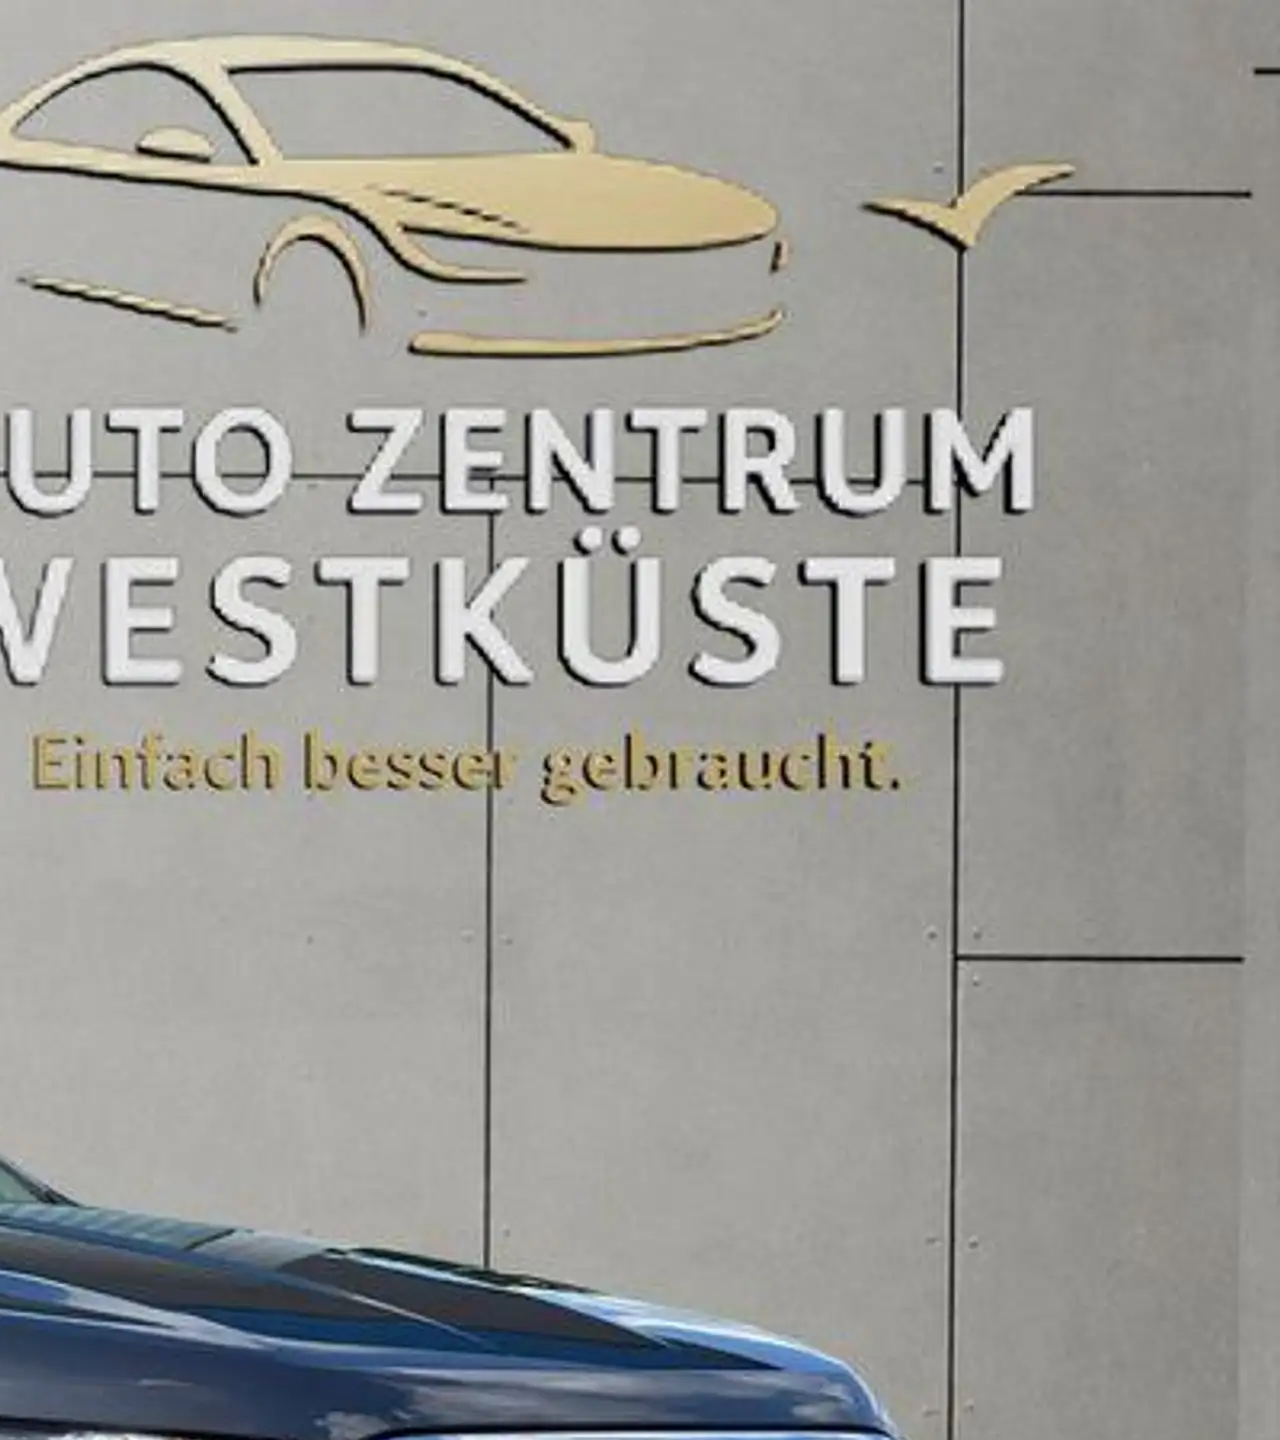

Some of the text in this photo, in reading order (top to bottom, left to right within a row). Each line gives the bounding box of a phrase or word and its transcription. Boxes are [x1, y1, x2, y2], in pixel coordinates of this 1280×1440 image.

[346, 407, 1035, 516] ZENTRUM
[30, 727, 902, 807] Einfach besser gebraucht.
